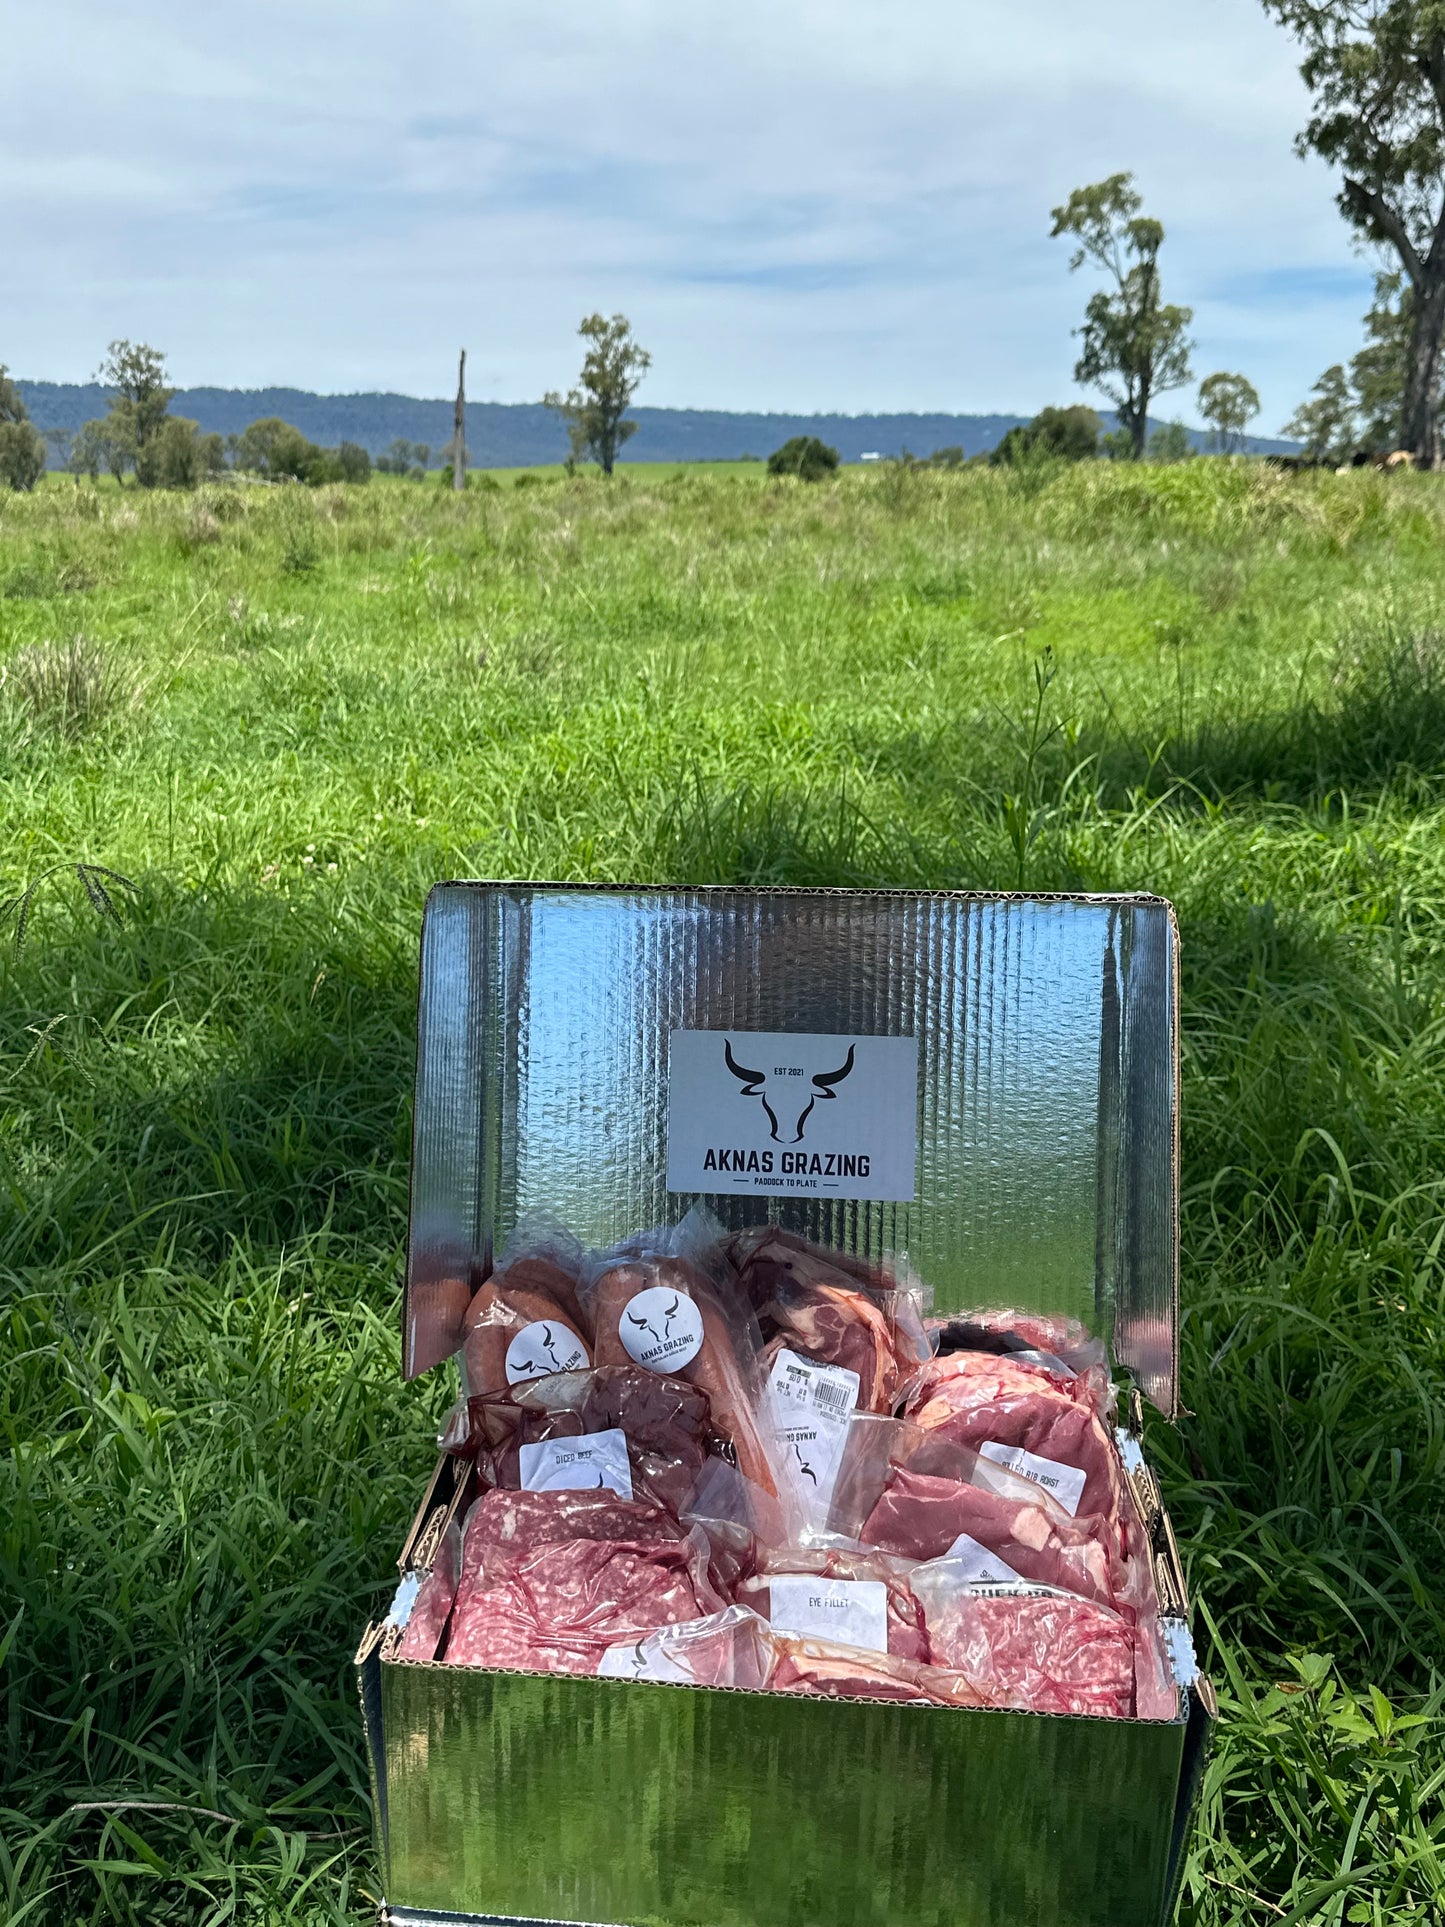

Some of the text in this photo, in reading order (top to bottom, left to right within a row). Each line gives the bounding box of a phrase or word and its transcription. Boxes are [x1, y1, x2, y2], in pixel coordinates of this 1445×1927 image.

[773, 1067, 804, 1077] EST 2021
[703, 1148, 870, 1178] AKNAS GRAZING
[754, 1177, 818, 1188] PADDOCK TO PLATE
[640, 1334, 694, 1361] AKNAS GRAZING
[560, 1350, 582, 1372] RAZING
[795, 1431, 818, 1441] AKNAS
[555, 1450, 593, 1465] DICED BEEF
[1026, 1470, 1039, 1482] RIB
[1040, 1474, 1060, 1488] ROAST
[808, 1596, 849, 1608] EYE FILLET
